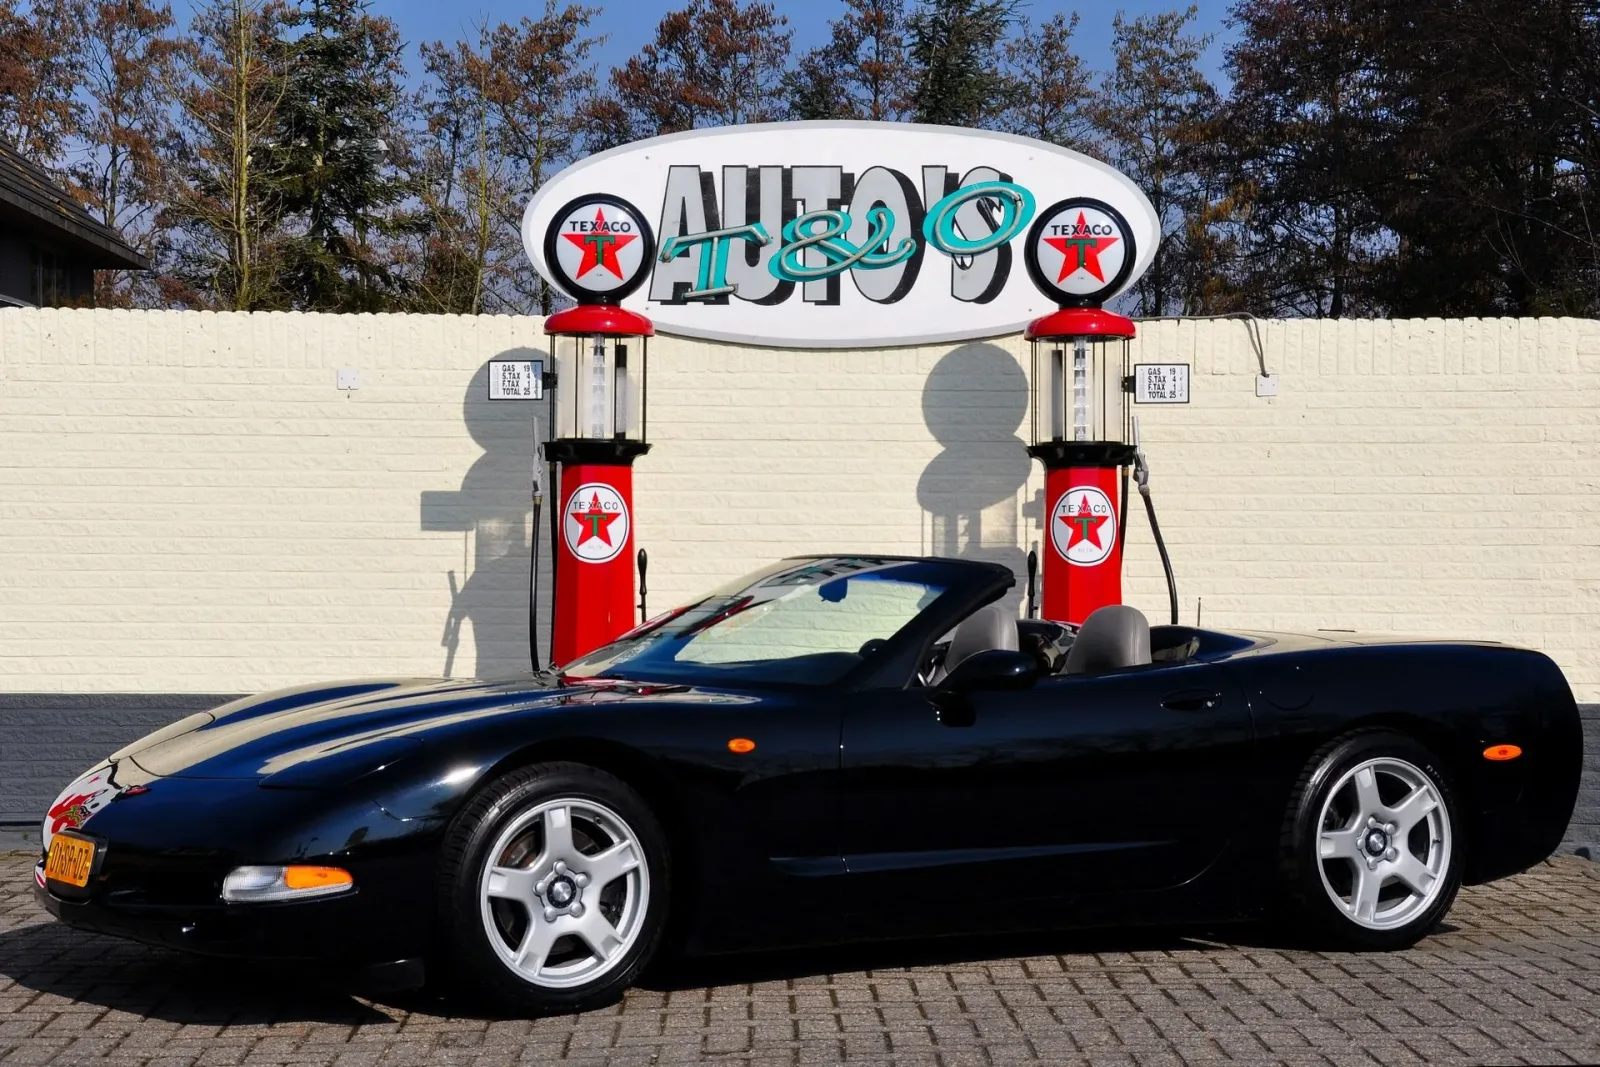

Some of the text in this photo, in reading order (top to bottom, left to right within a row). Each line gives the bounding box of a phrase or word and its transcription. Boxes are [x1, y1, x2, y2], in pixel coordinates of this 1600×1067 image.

[569, 220, 631, 233] TEXACO
[1050, 224, 1113, 236] TEXACO
[648, 165, 1013, 305] AUTO'S
[658, 181, 1036, 299] T & O
[583, 235, 616, 265] T
[1066, 238, 1098, 268] T
[502, 364, 531, 372] GAS 19
[1147, 367, 1176, 376] GAS 19
[502, 372, 521, 380] S.TAX
[1147, 375, 1167, 383] S.TAX
[502, 380, 520, 388] F.TAX
[1147, 383, 1166, 391] F.TAX
[502, 387, 531, 396] TOTAL 25
[1147, 390, 1177, 399] TOTAL 25
[573, 501, 619, 511] TEXACO
[1061, 504, 1107, 514] TEXACO
[583, 514, 608, 537] T
[1073, 517, 1098, 540] T
